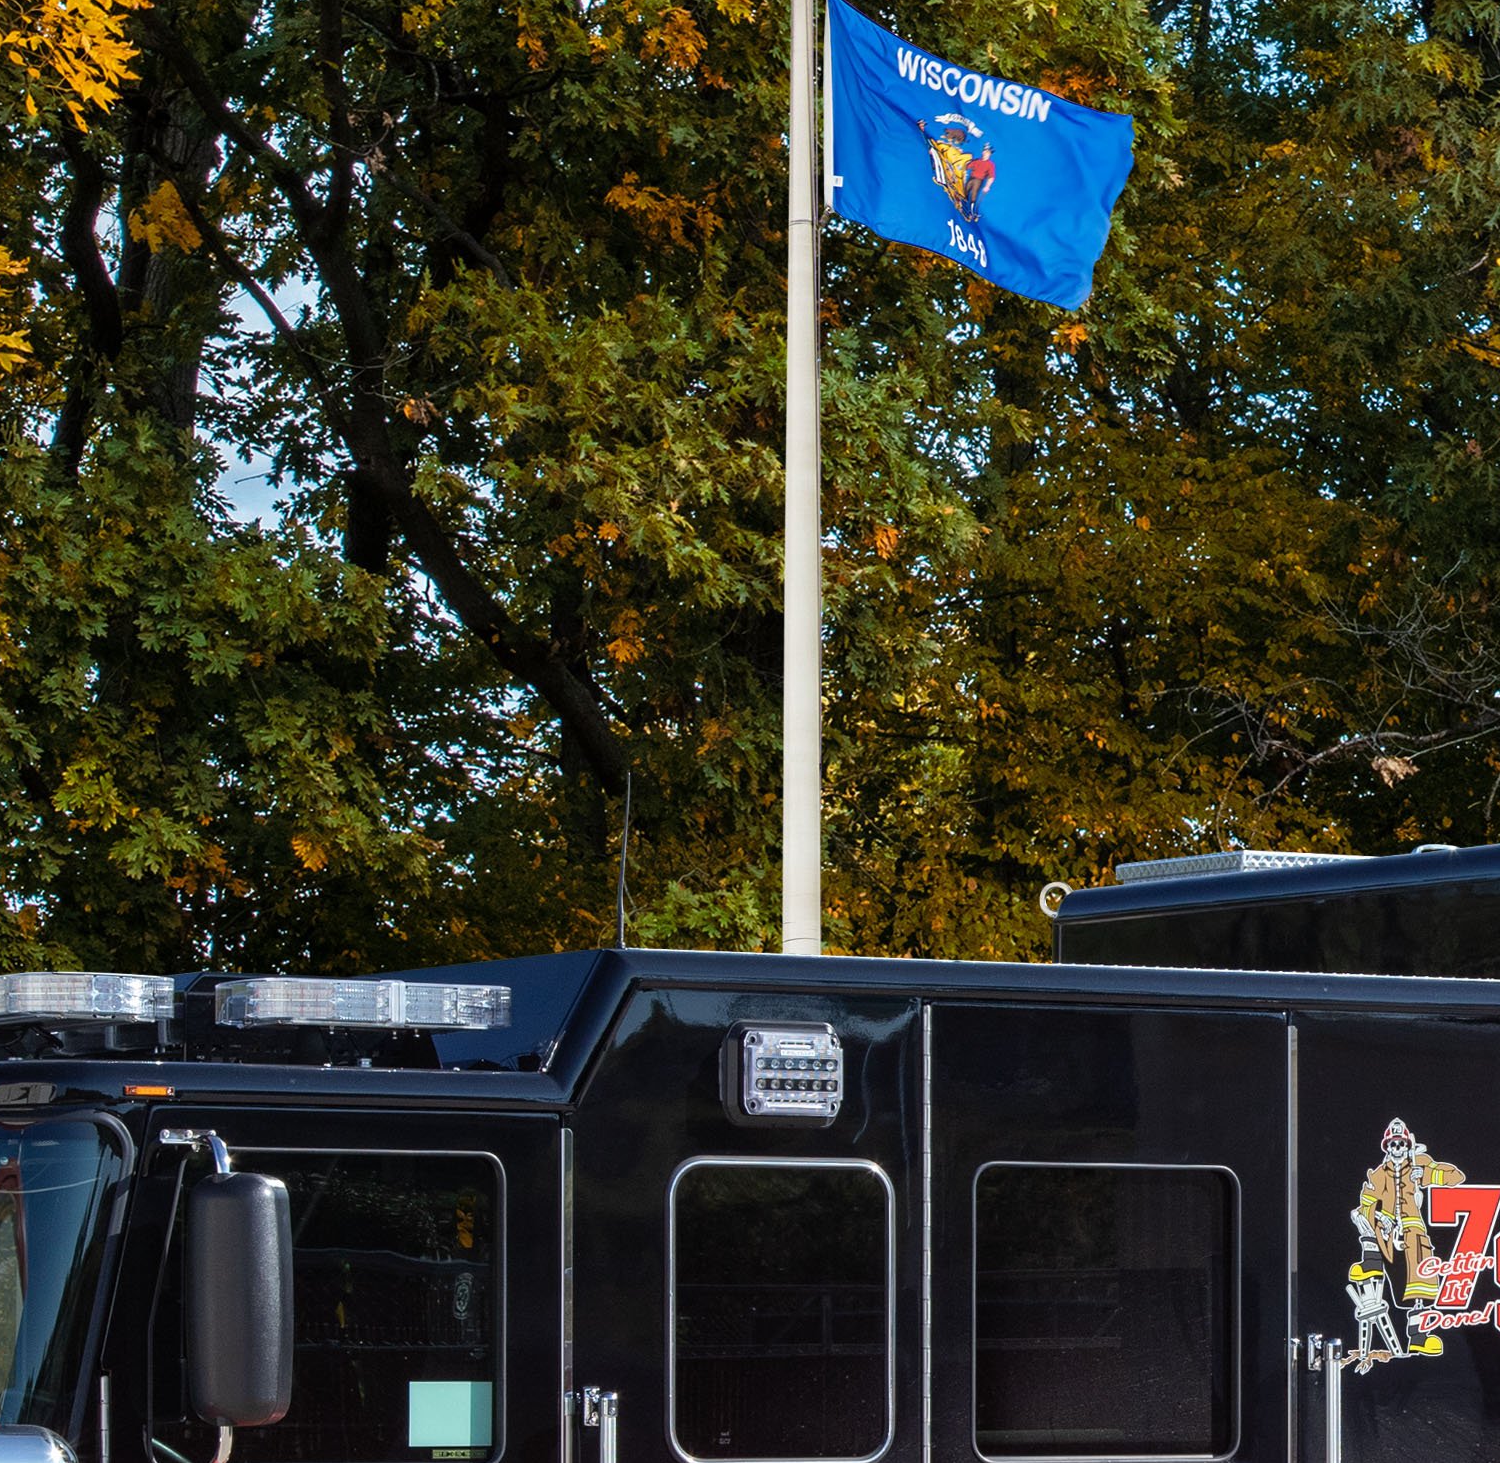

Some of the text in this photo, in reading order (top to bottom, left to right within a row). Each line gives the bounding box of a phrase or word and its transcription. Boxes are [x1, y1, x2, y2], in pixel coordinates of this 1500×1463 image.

[897, 47, 1051, 122] WISCONSIN
[948, 219, 987, 268] 1848
[1417, 1251, 1495, 1279] Gettin
[1441, 1279, 1472, 1302] It
[1419, 1301, 1496, 1333] Done!
